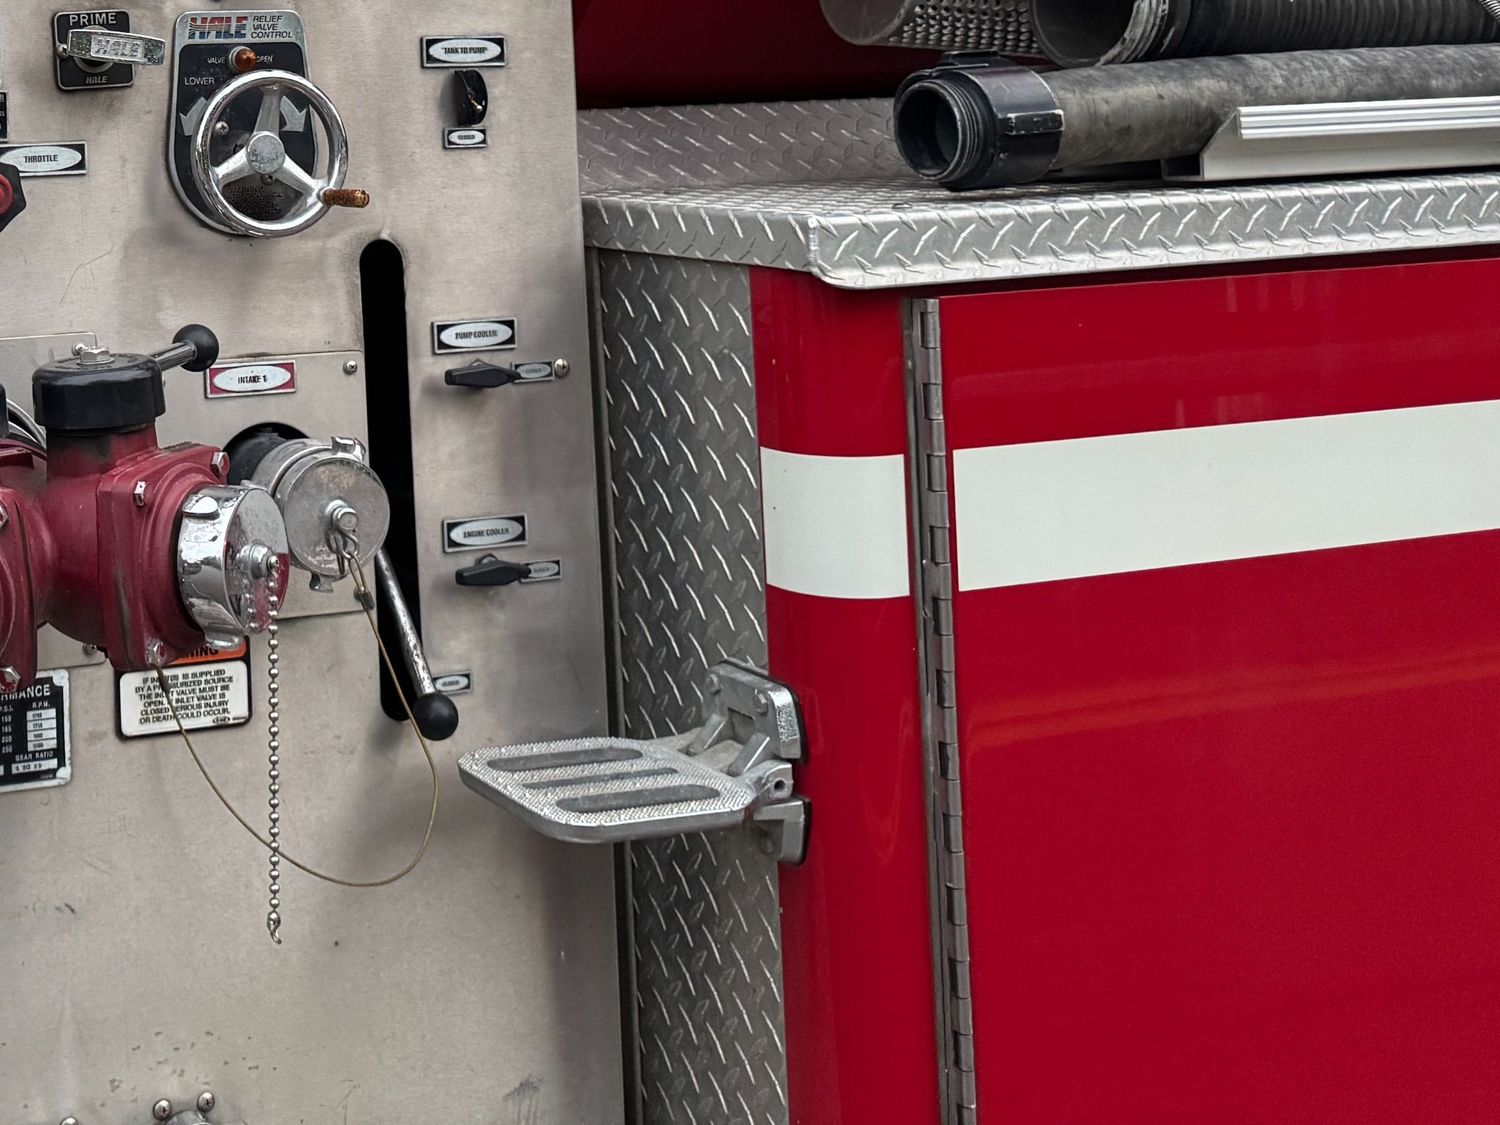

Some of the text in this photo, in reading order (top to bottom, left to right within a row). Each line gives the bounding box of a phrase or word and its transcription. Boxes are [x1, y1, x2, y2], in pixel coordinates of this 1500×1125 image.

[69, 13, 117, 26] PRIME
[252, 15, 283, 23] RELIEF
[188, 16, 248, 39] HALE
[253, 23, 279, 31] VALVE
[250, 31, 293, 39] CONTROL
[444, 47, 460, 55] TANK
[256, 55, 274, 63] OPEN
[86, 75, 108, 83] HALE
[184, 77, 215, 85] LOWER
[24, 155, 58, 163] THROTTLE
[454, 330, 498, 339] PUMP COOLER
[238, 375, 260, 384] INTAKE
[464, 527, 510, 538] ENGINE COOLER
[190, 669, 226, 679] SUPPLIED
[204, 676, 234, 685] SOURCE
[139, 693, 153, 701] THE
[176, 687, 197, 695] VALVE
[198, 685, 218, 693] MUST
[176, 696, 194, 705] INLET
[196, 693, 217, 701] VALVE
[140, 699, 229, 716] CLOSED INJURY
[36, 751, 54, 759] RATIO
